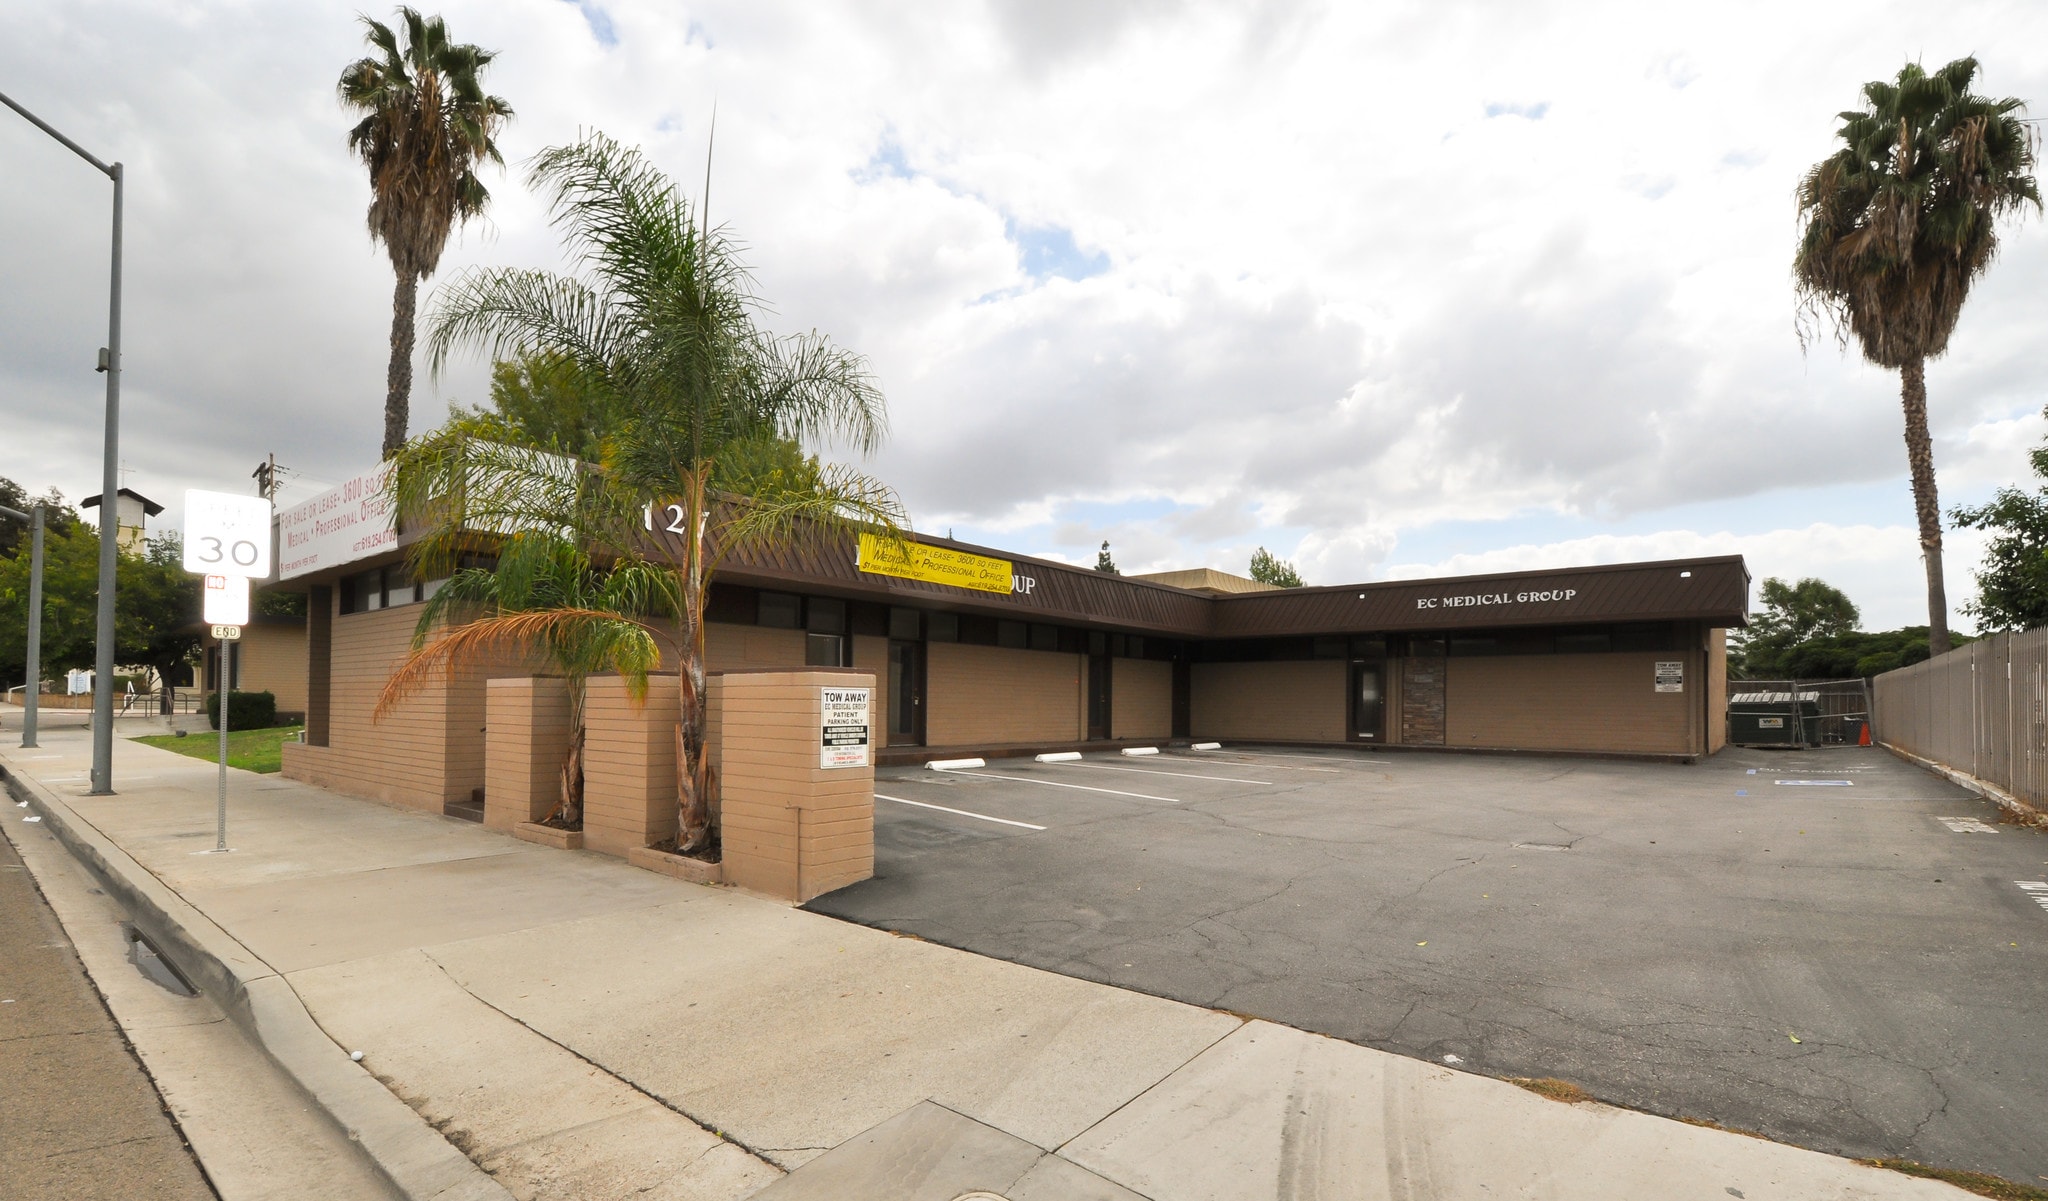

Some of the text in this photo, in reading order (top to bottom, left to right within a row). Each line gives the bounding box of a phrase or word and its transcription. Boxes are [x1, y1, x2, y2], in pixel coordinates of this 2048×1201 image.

[294, 507, 307, 525] SALE
[309, 502, 317, 518] OR
[343, 477, 361, 503] 3600
[365, 478, 374, 495] SQ
[287, 530, 309, 549] MEDICAL
[315, 510, 358, 538] PROFESSIONAL
[198, 536, 259, 567] 30
[916, 547, 928, 557] OR
[956, 554, 976, 566] 3600
[976, 559, 987, 568] SQ
[988, 561, 1004, 571] FEET
[921, 558, 977, 578] PROFESSIONAL
[979, 569, 1006, 583] OFFICE
[1417, 589, 1577, 609] EC MEDICAL GROUP
[216, 626, 237, 638] END
[825, 692, 867, 702] TOW AWAY
